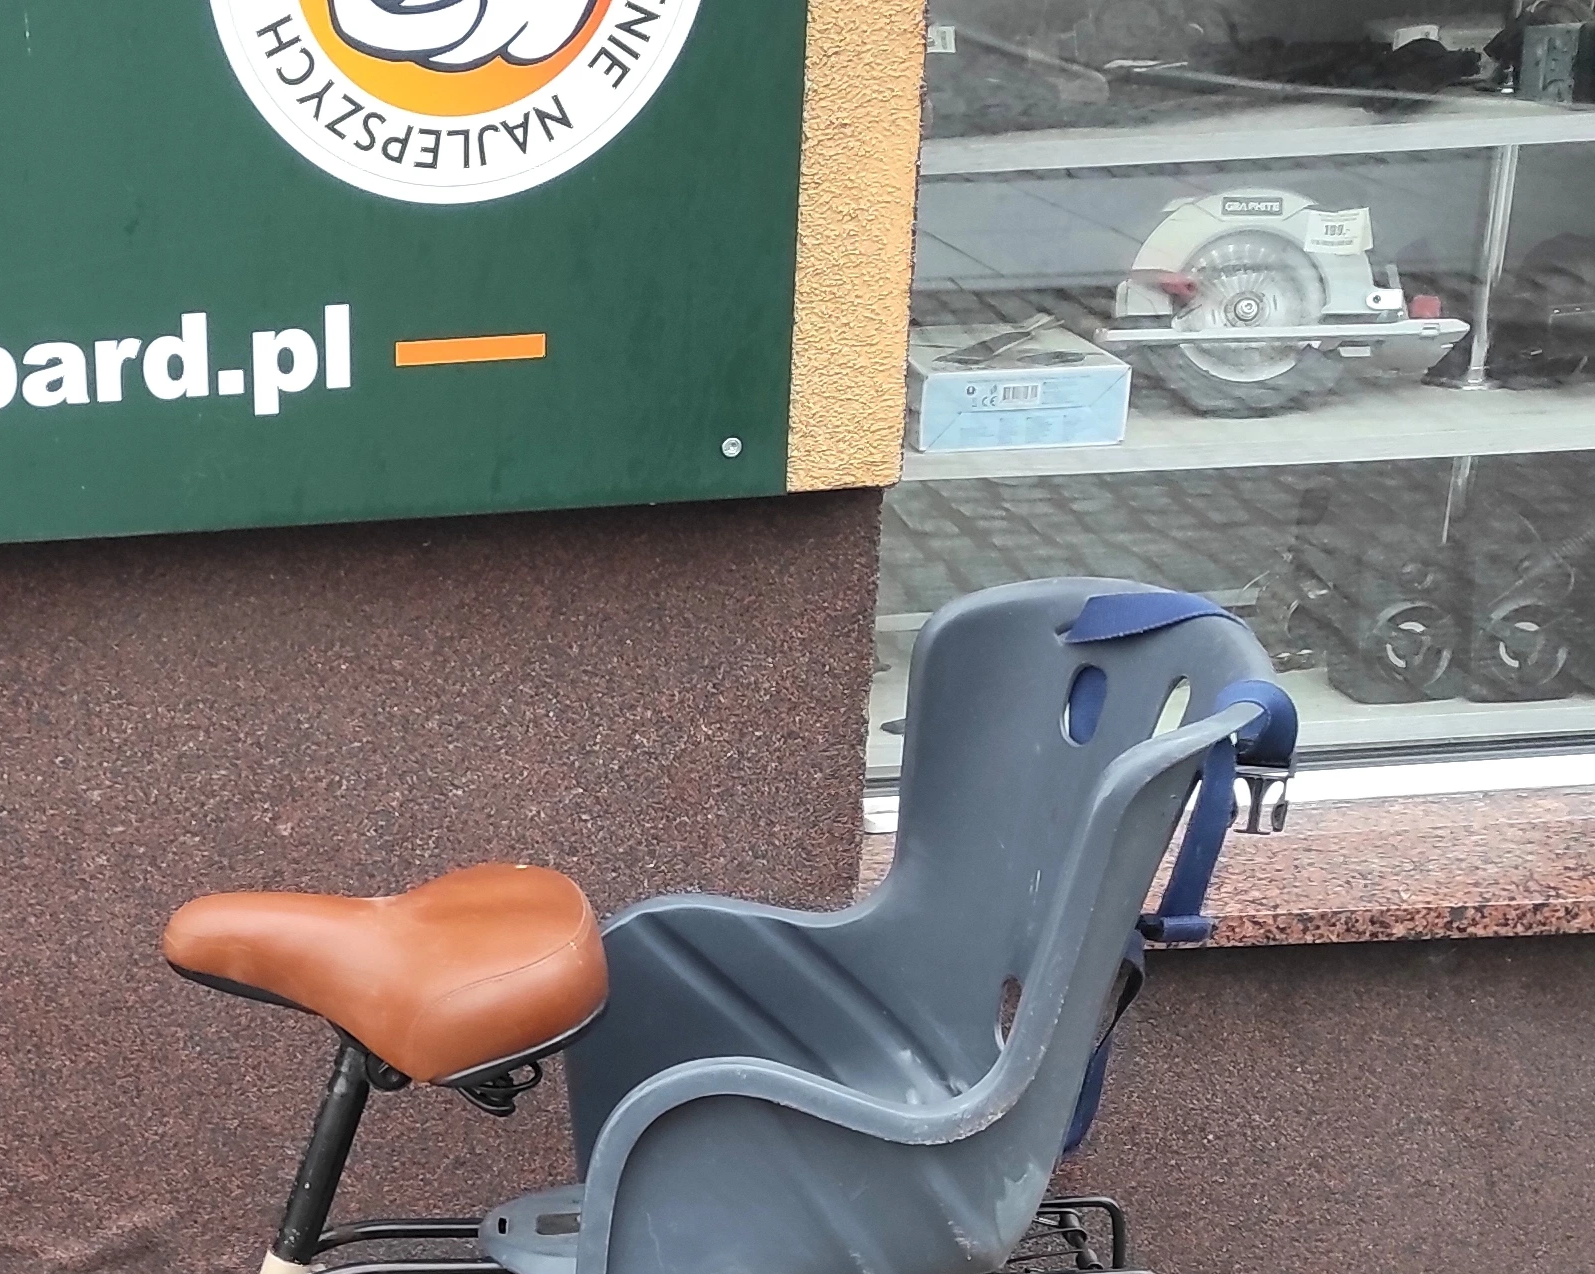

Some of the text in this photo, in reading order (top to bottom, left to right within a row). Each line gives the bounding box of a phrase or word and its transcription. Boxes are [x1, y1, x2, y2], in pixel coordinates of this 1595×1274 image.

[256, 0, 666, 169] NIE NAJLEPSZYCH
[1224, 200, 1281, 212] GRAPHITE
